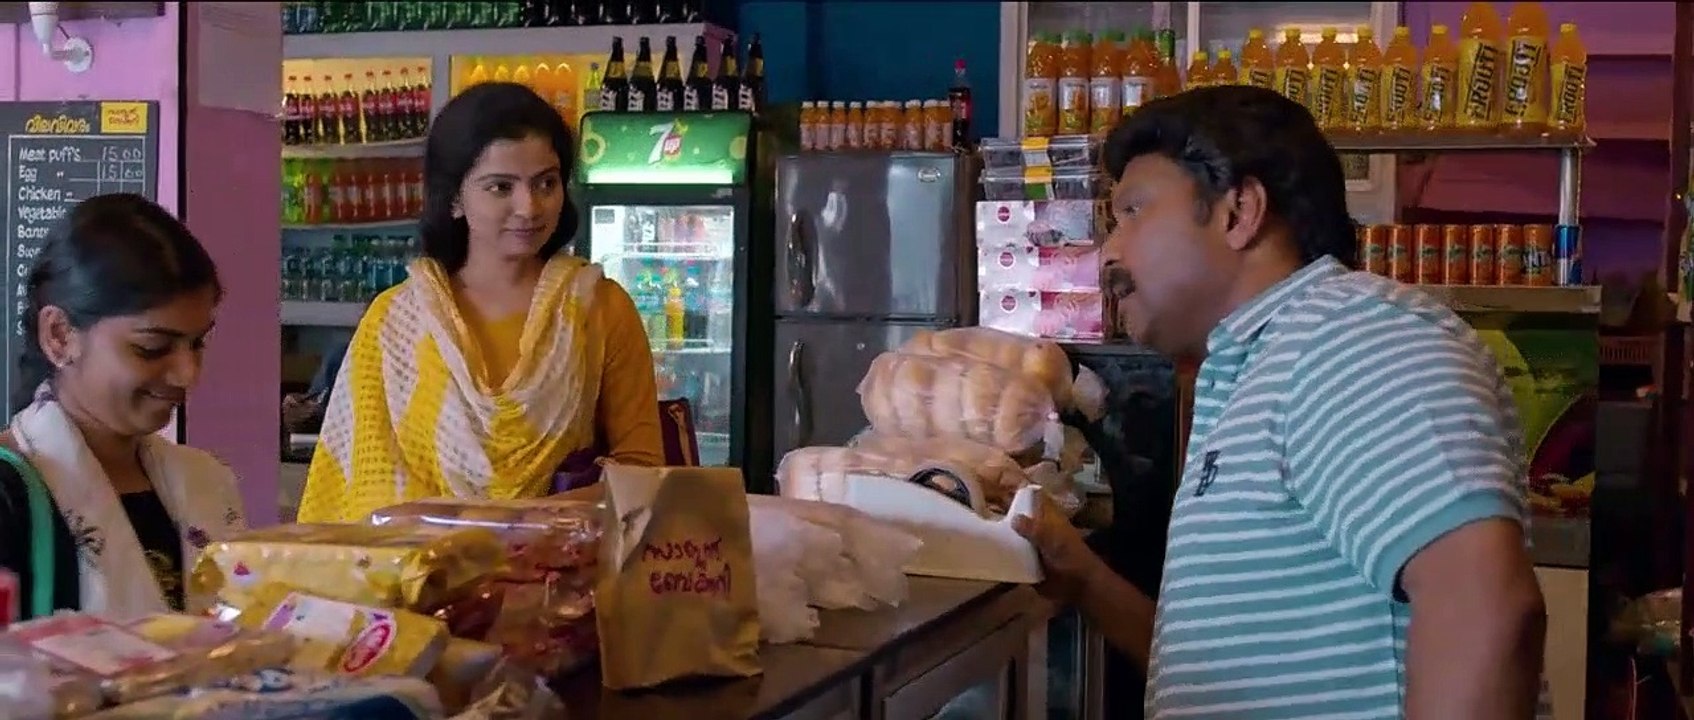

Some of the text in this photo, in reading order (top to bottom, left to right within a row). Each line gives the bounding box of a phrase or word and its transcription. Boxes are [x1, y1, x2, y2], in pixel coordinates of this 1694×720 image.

[19, 148, 46, 162] Meat
[19, 165, 37, 183] Egg
[18, 185, 61, 201] Chicken
